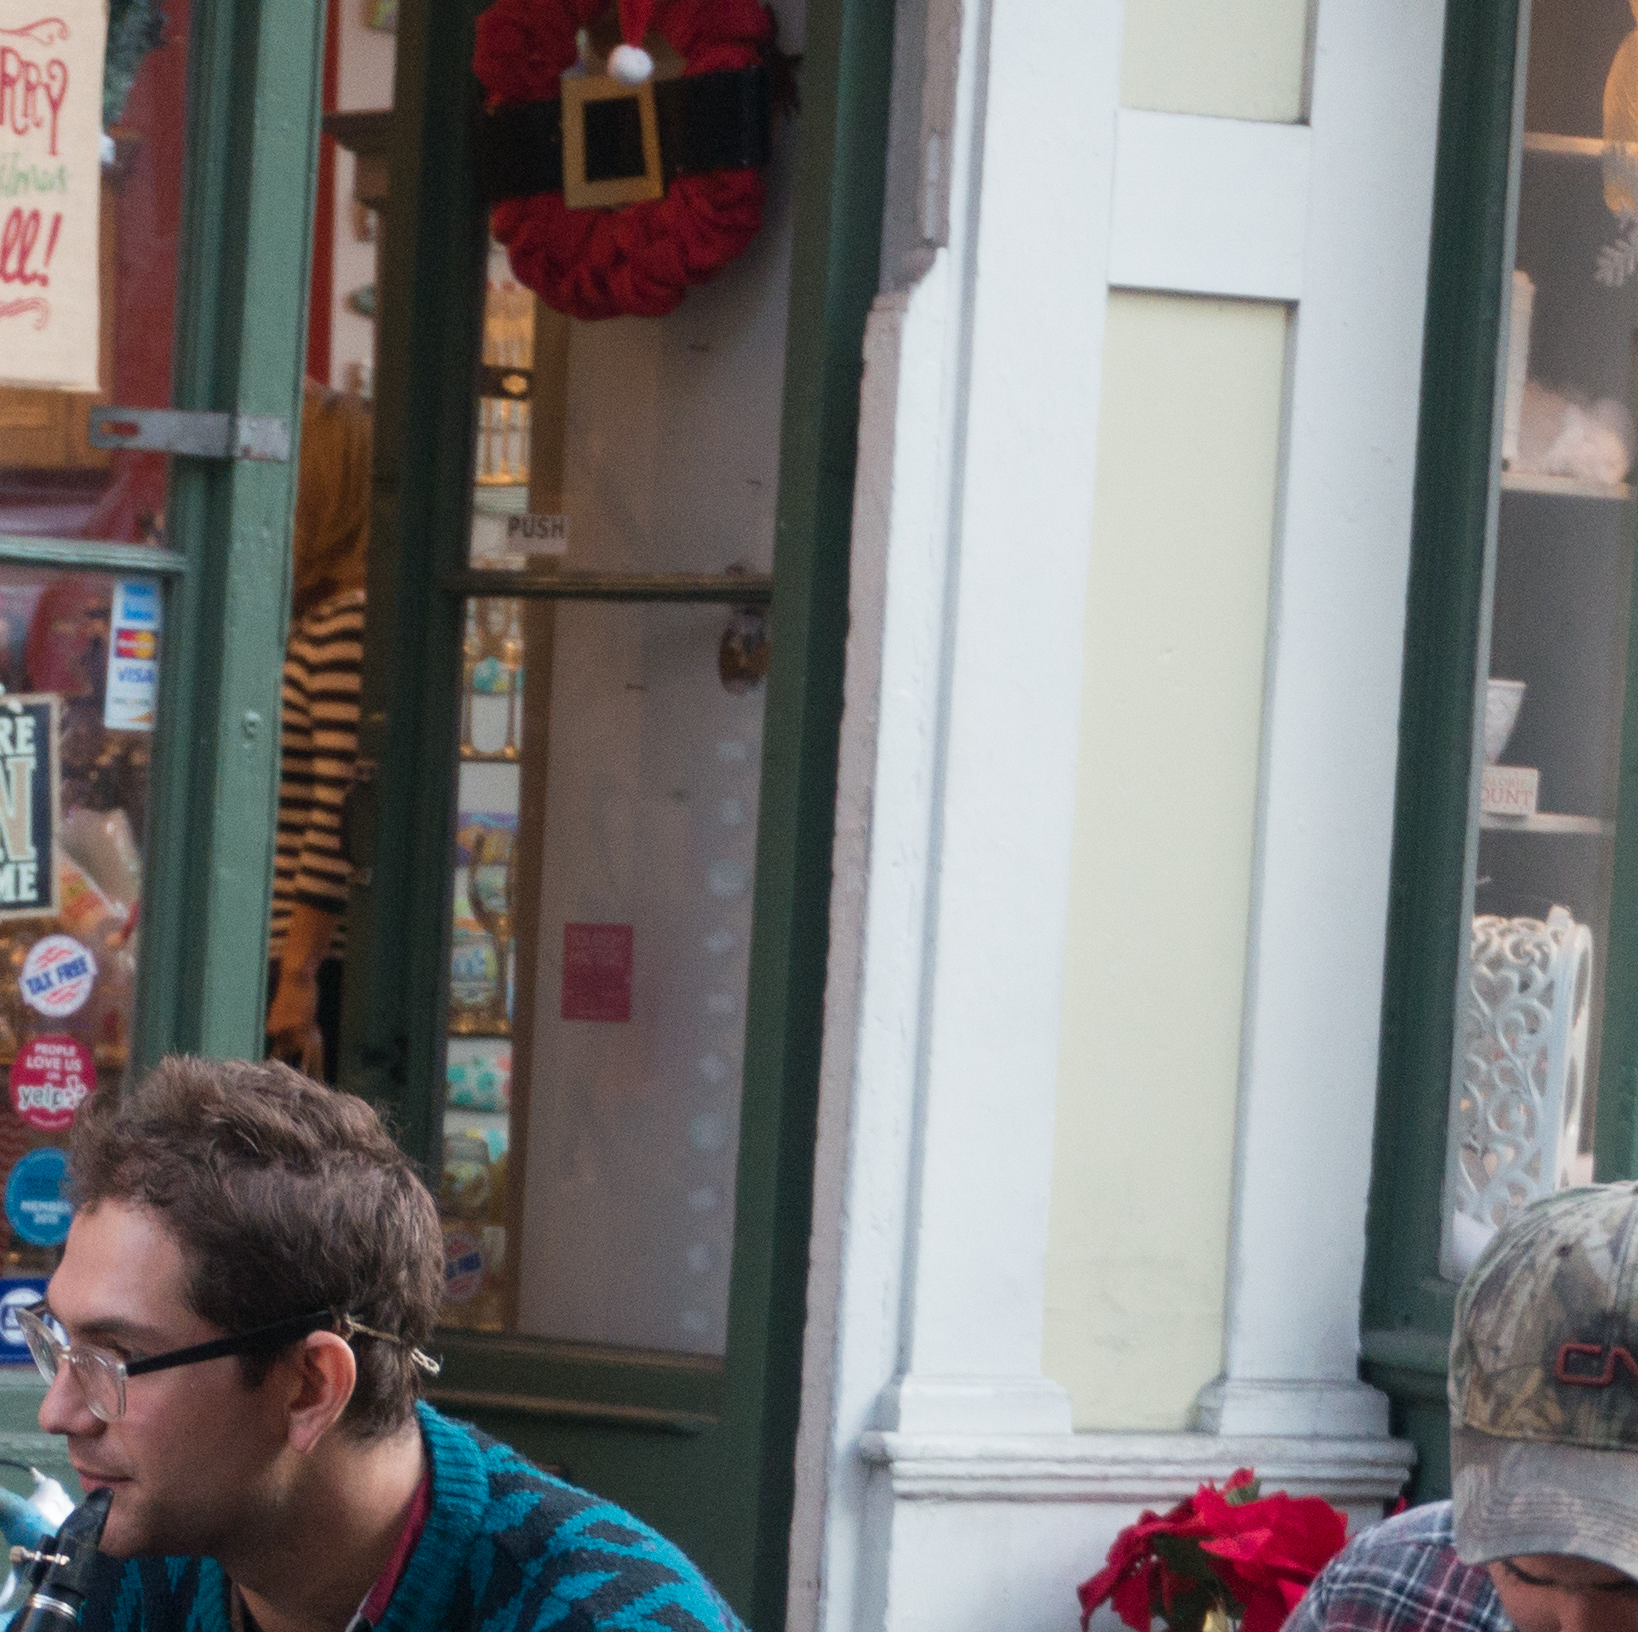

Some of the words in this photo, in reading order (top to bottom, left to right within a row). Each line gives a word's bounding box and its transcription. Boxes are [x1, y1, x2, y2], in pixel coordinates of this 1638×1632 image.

[508, 517, 564, 539] PUSH
[118, 667, 156, 684] VISA
[26, 969, 55, 996] TAX
[56, 955, 89, 983] FREE
[34, 1043, 77, 1057] PEOPLE
[25, 1054, 61, 1070] LOVE
[64, 1057, 82, 1072] US
